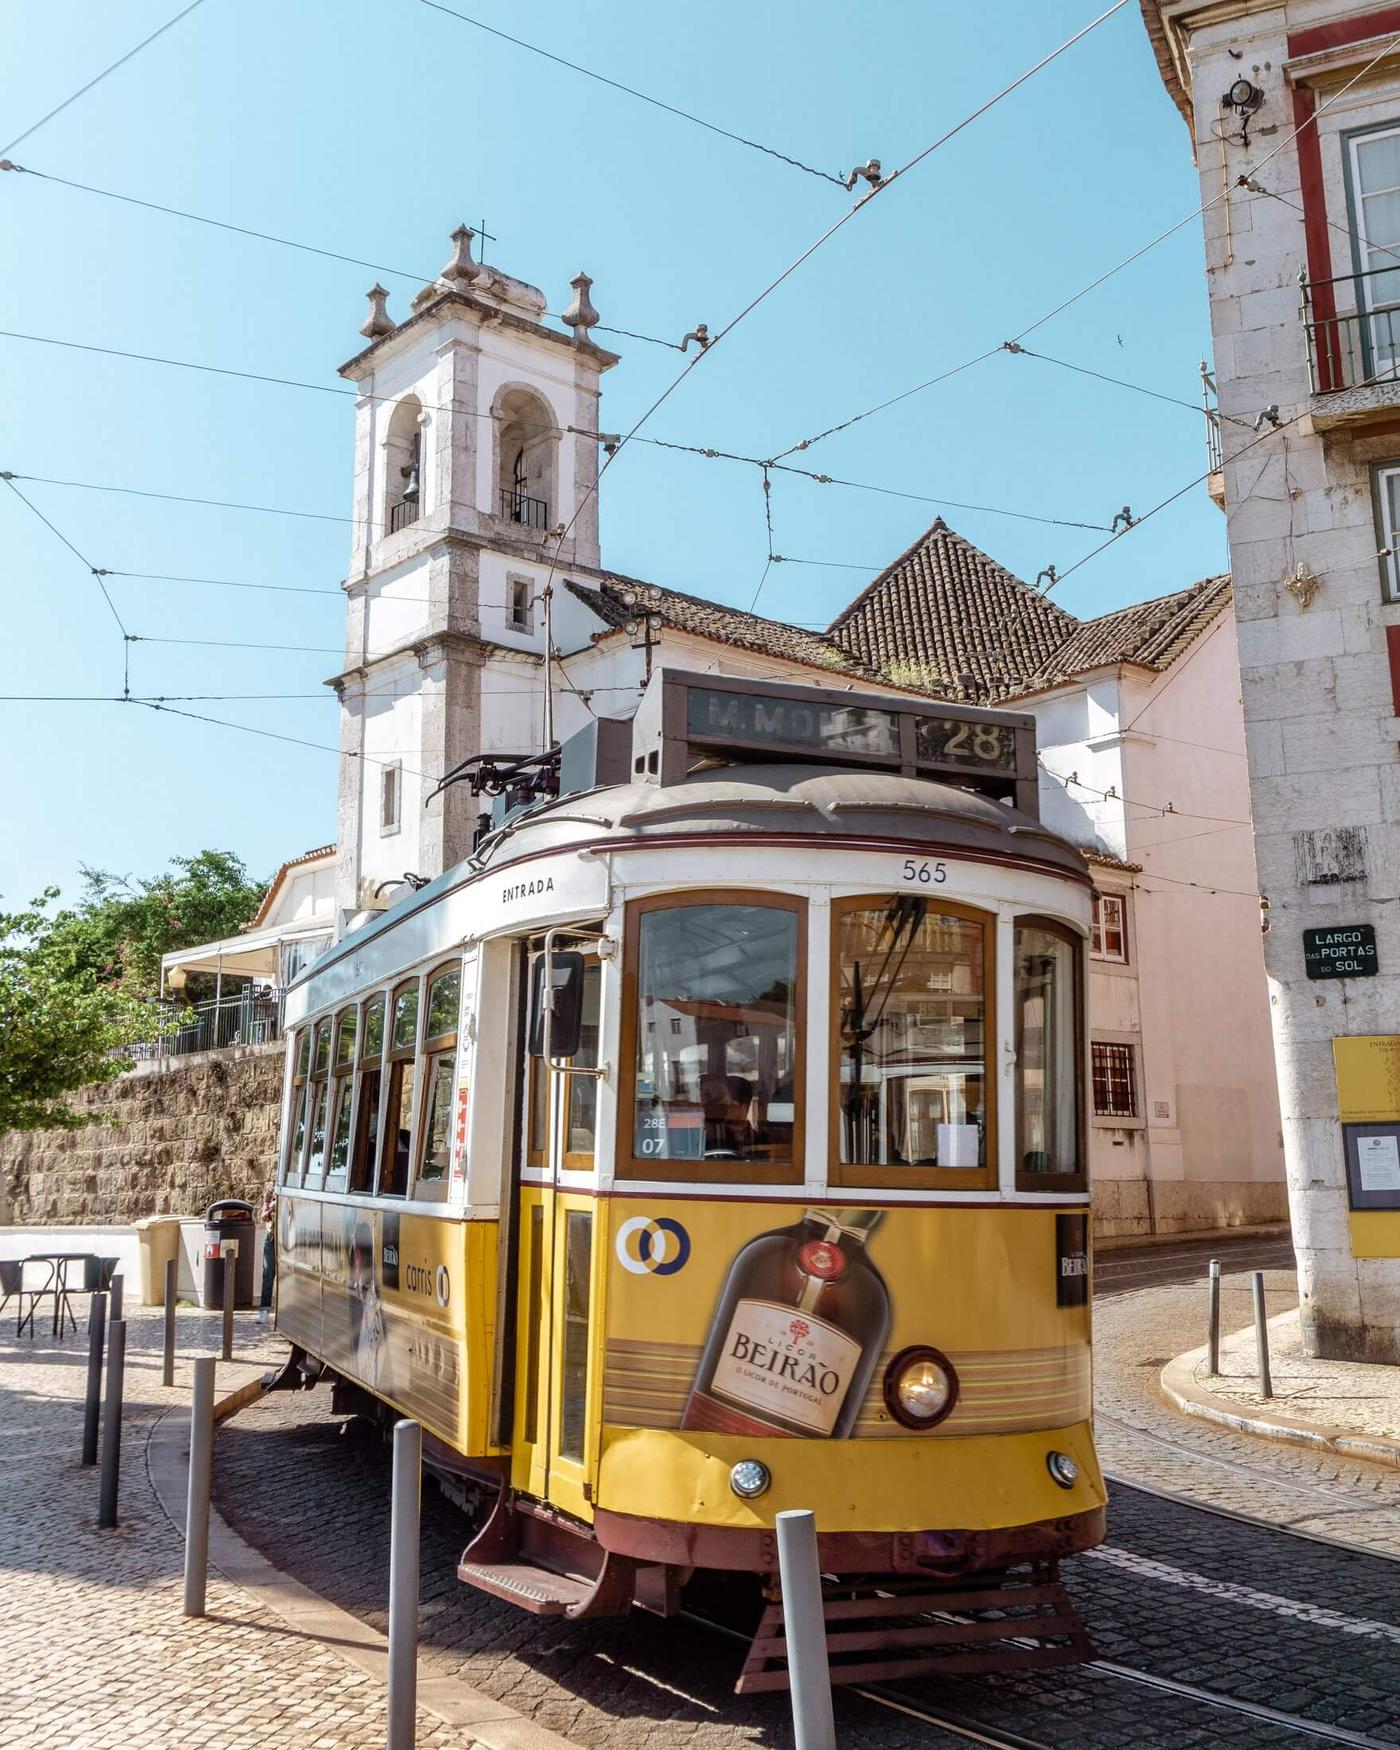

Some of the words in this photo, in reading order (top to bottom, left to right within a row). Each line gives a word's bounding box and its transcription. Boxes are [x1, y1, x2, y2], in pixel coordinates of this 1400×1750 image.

[944, 721, 1001, 760] 28
[903, 860, 946, 883] 565
[502, 877, 554, 903] ENTRADA
[1315, 931, 1361, 945] LARGO
[1321, 945, 1375, 959] PORTAS
[1335, 960, 1363, 971] SOL
[643, 1118, 666, 1129] 28E
[642, 1138, 665, 1154] 07
[768, 1337, 817, 1361] LICOR
[730, 1332, 839, 1395] BEIRÃO
[736, 1366, 742, 1374] O
[743, 1368, 767, 1384] LICOR
[768, 1379, 780, 1389] DE
[781, 1384, 823, 1406] PORTUGAL
